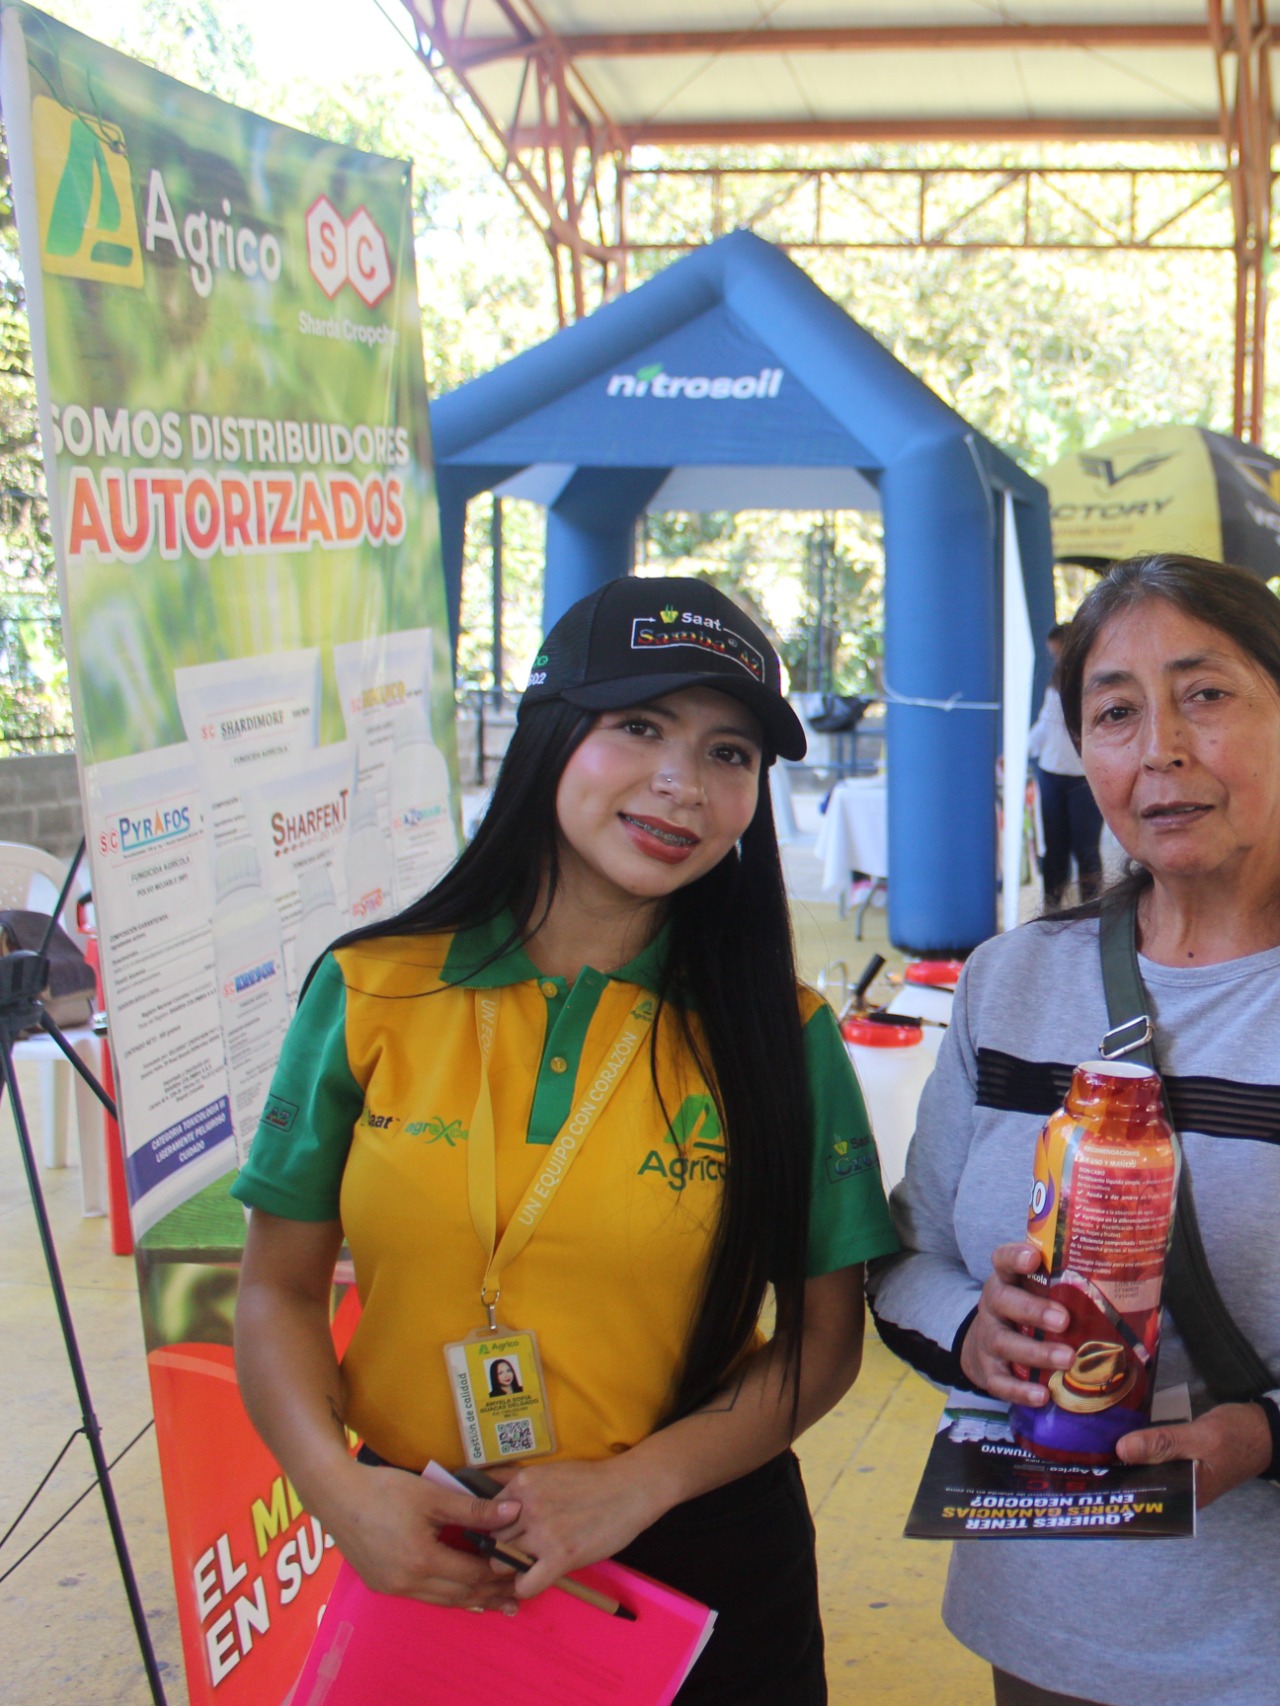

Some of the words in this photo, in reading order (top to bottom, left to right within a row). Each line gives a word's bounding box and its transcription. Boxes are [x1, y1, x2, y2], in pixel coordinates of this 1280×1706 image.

[146, 168, 281, 298] Agrico
[190, 413, 411, 467] DISTRIBUIDORES
[67, 472, 406, 557] AUTORIZADOS
[118, 806, 191, 852] PYRAFOS
[272, 788, 349, 846] SHARFENT
[518, 1197, 542, 1227] UN
[533, 1136, 577, 1199] EQUIPO
[569, 1101, 597, 1137] CON
[588, 1030, 638, 1103] CORAZÓN
[491, 1340, 520, 1352] Agrico
[457, 1372, 473, 1409] calidad
[466, 1409, 476, 1422] de
[468, 1424, 483, 1459] Gestión
[1049, 1466, 1090, 1475] Agrico
[942, 1505, 1062, 1518] GANANCIAS
[970, 1494, 1073, 1508] NEGOCIO?
[1066, 1502, 1164, 1516] MAYORES
[1076, 1494, 1104, 1505] TU
[1108, 1493, 1135, 1504] EN
[965, 1516, 1028, 1530] TENER
[1033, 1510, 1135, 1528] ¿QUIERES
[192, 1532, 249, 1625] EL
[205, 1575, 271, 1689] EN
[275, 1514, 336, 1605] SU
